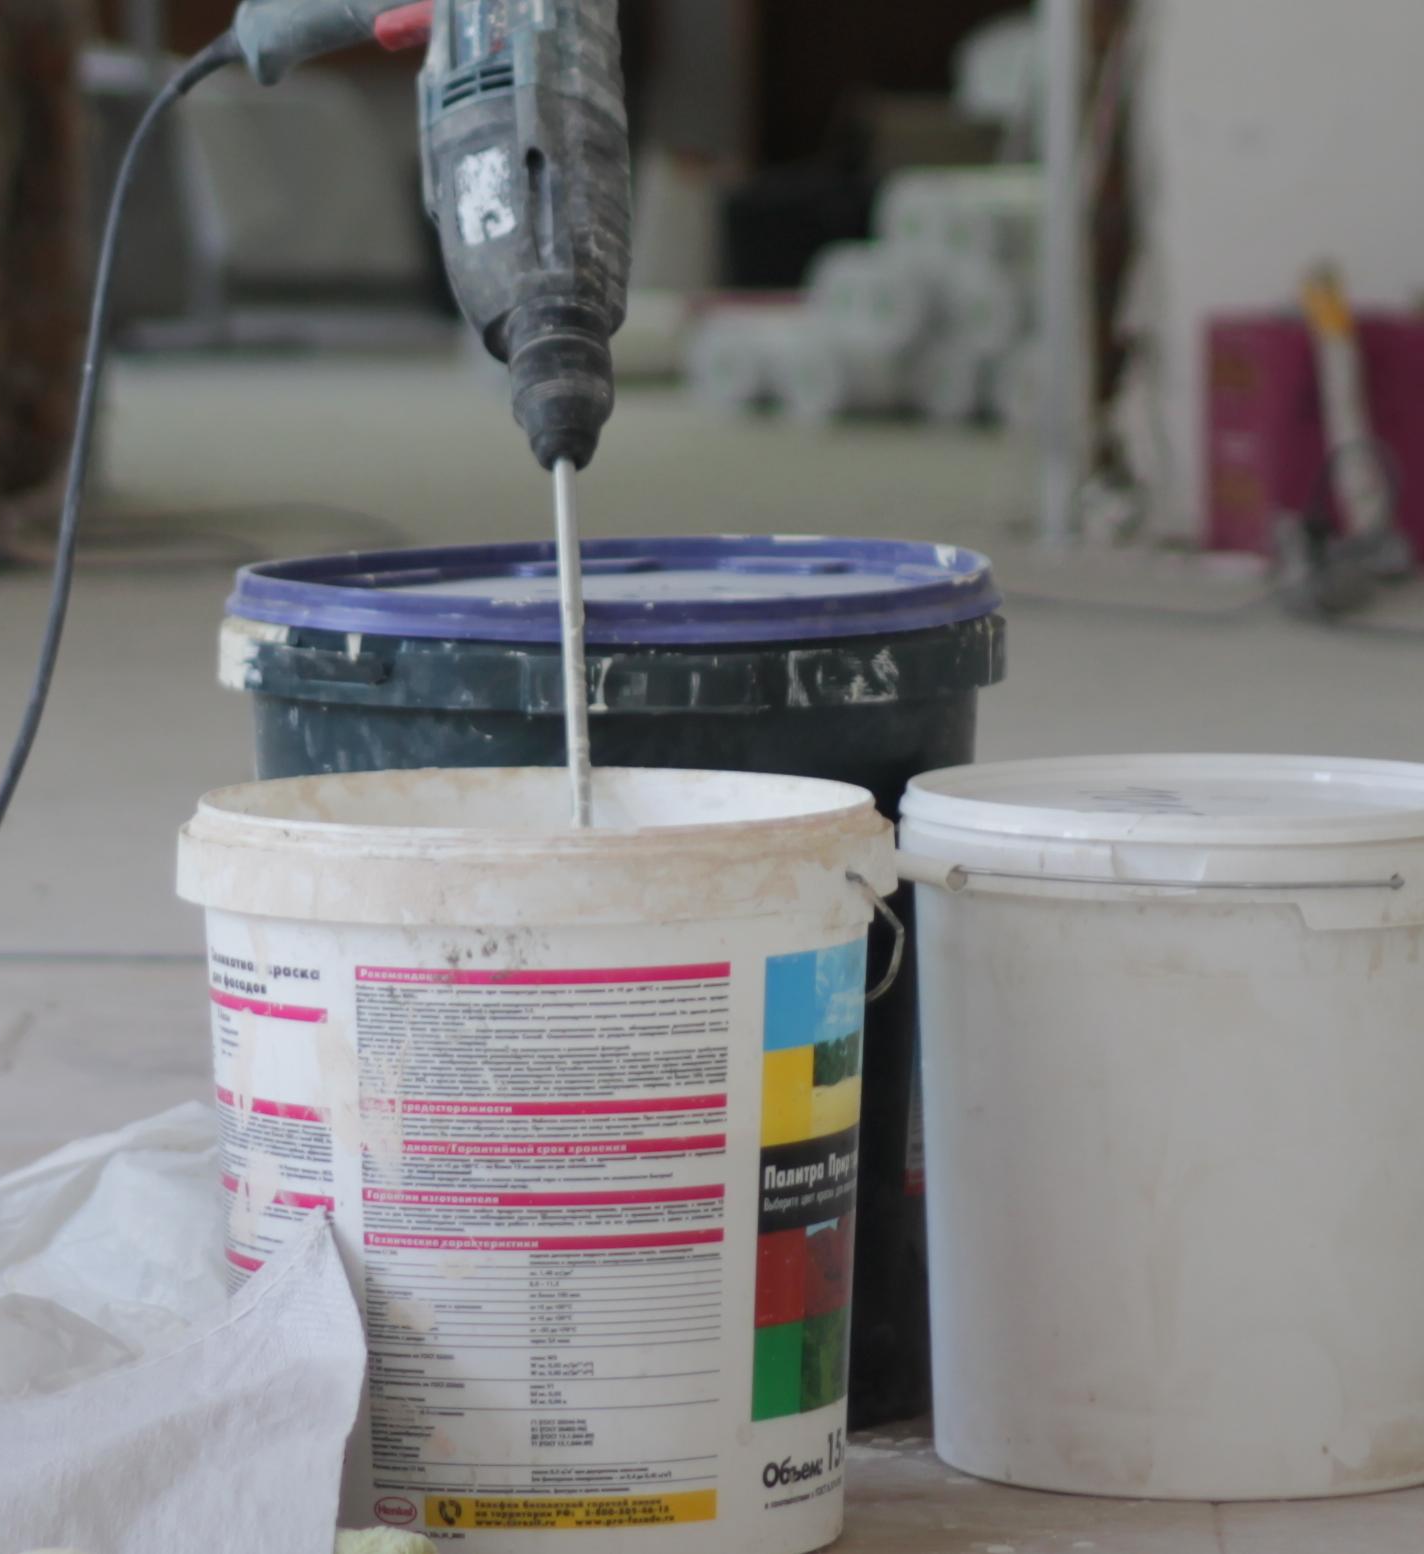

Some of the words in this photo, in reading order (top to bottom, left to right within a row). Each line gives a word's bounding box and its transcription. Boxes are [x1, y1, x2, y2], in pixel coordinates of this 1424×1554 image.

[266, 962, 320, 981] раска
[224, 973, 268, 995] фасадов
[764, 1162, 825, 1189] Палитра
[366, 1189, 420, 1203] Гарантии
[421, 1194, 500, 1205] изготовителя
[367, 1233, 440, 1248] Технические
[440, 1237, 539, 1250] характеристики
[377, 1502, 414, 1517] Henkel
